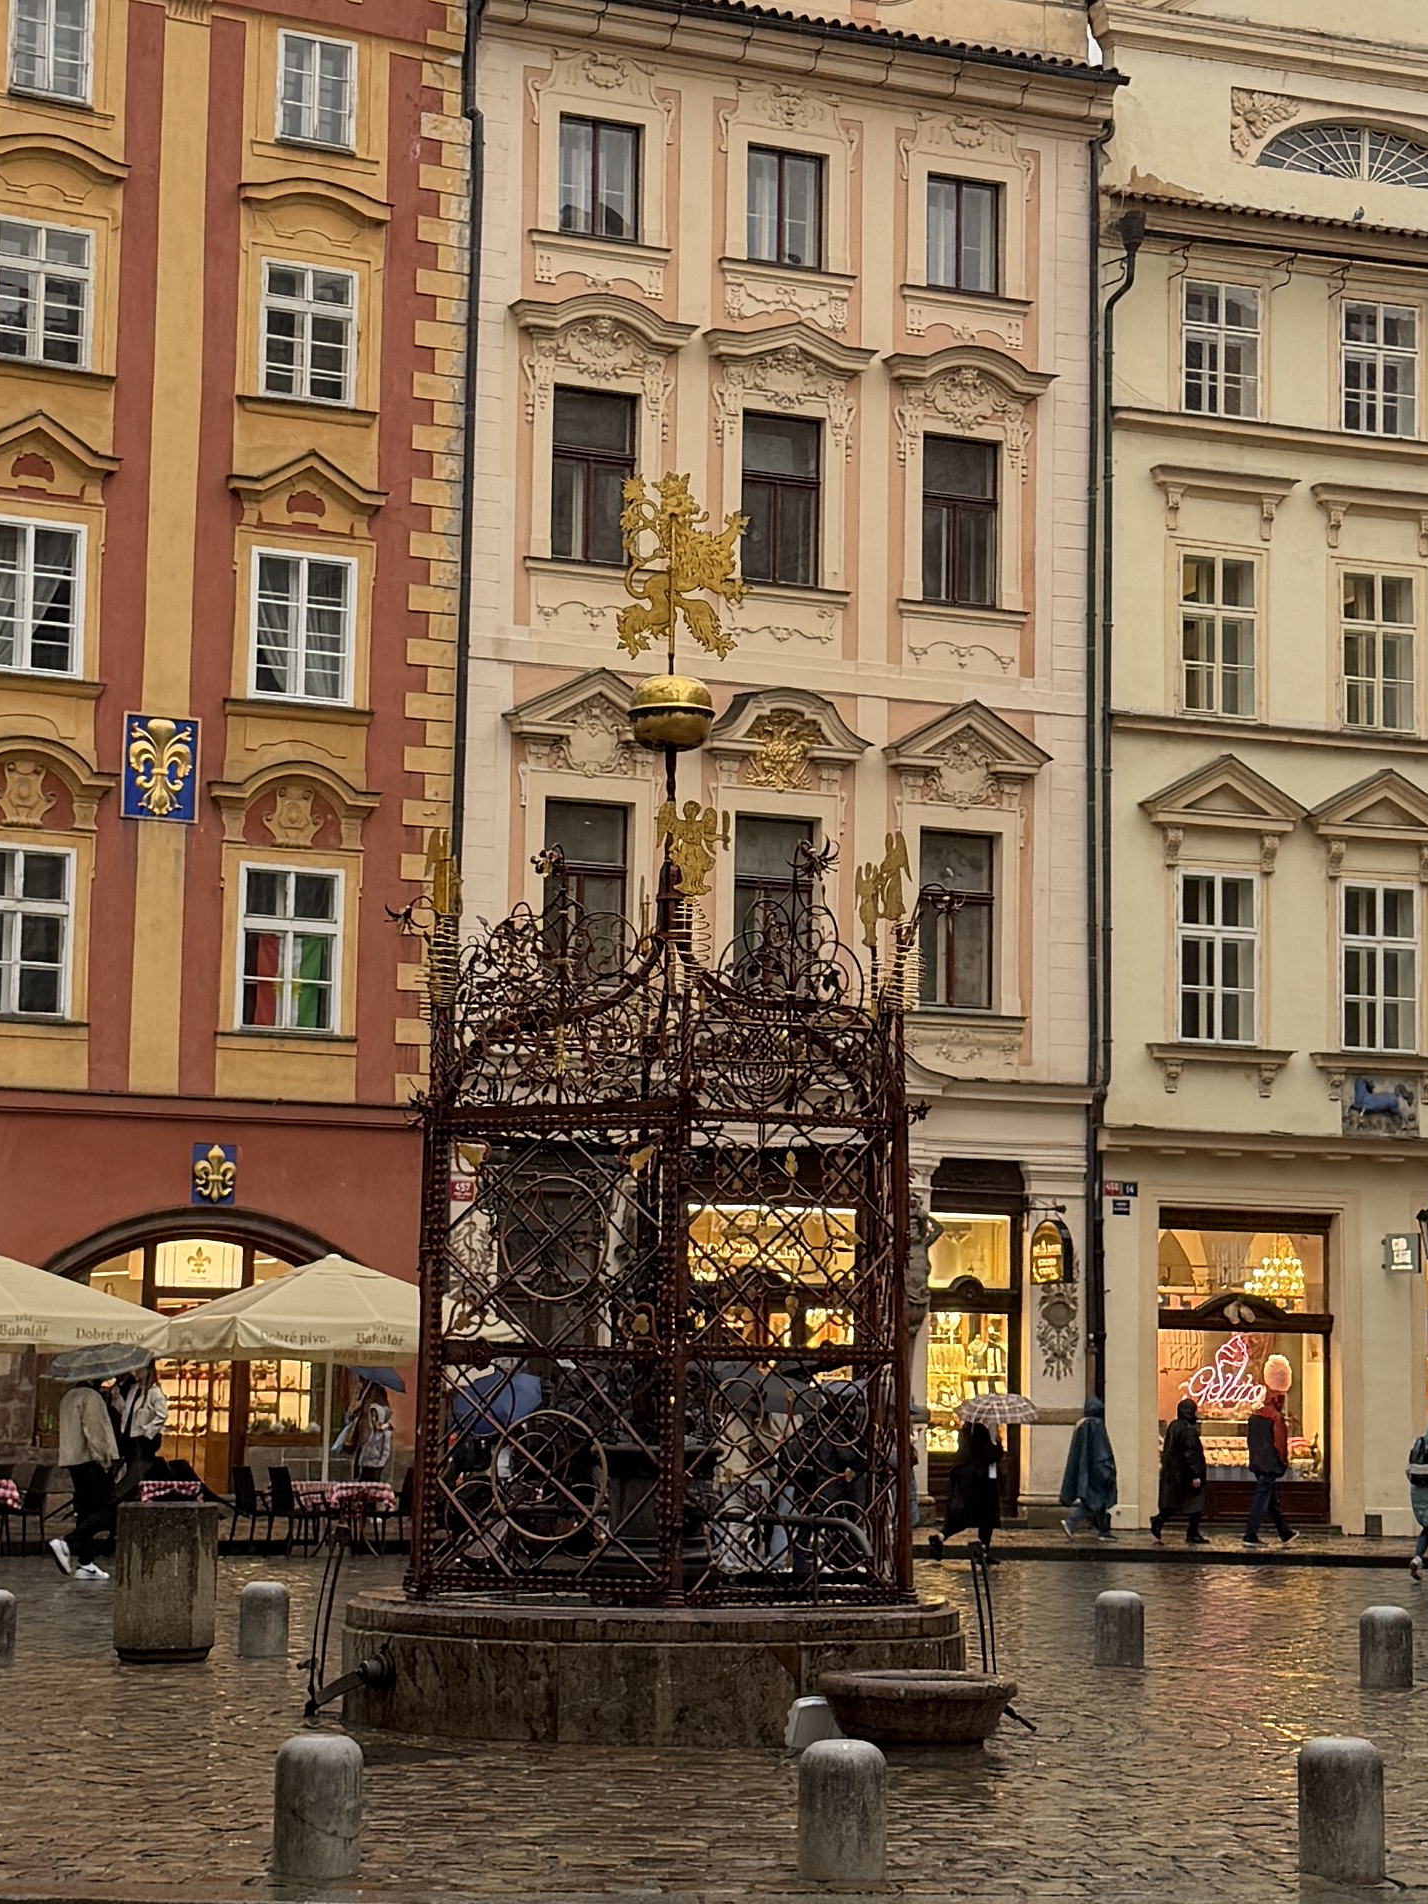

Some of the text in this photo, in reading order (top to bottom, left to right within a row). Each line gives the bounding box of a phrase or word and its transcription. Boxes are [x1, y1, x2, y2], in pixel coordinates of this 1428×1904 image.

[76, 1327, 115, 1340] Dobré
[299, 1331, 330, 1346] pivo.
[1188, 1366, 1267, 1407] Gelato
